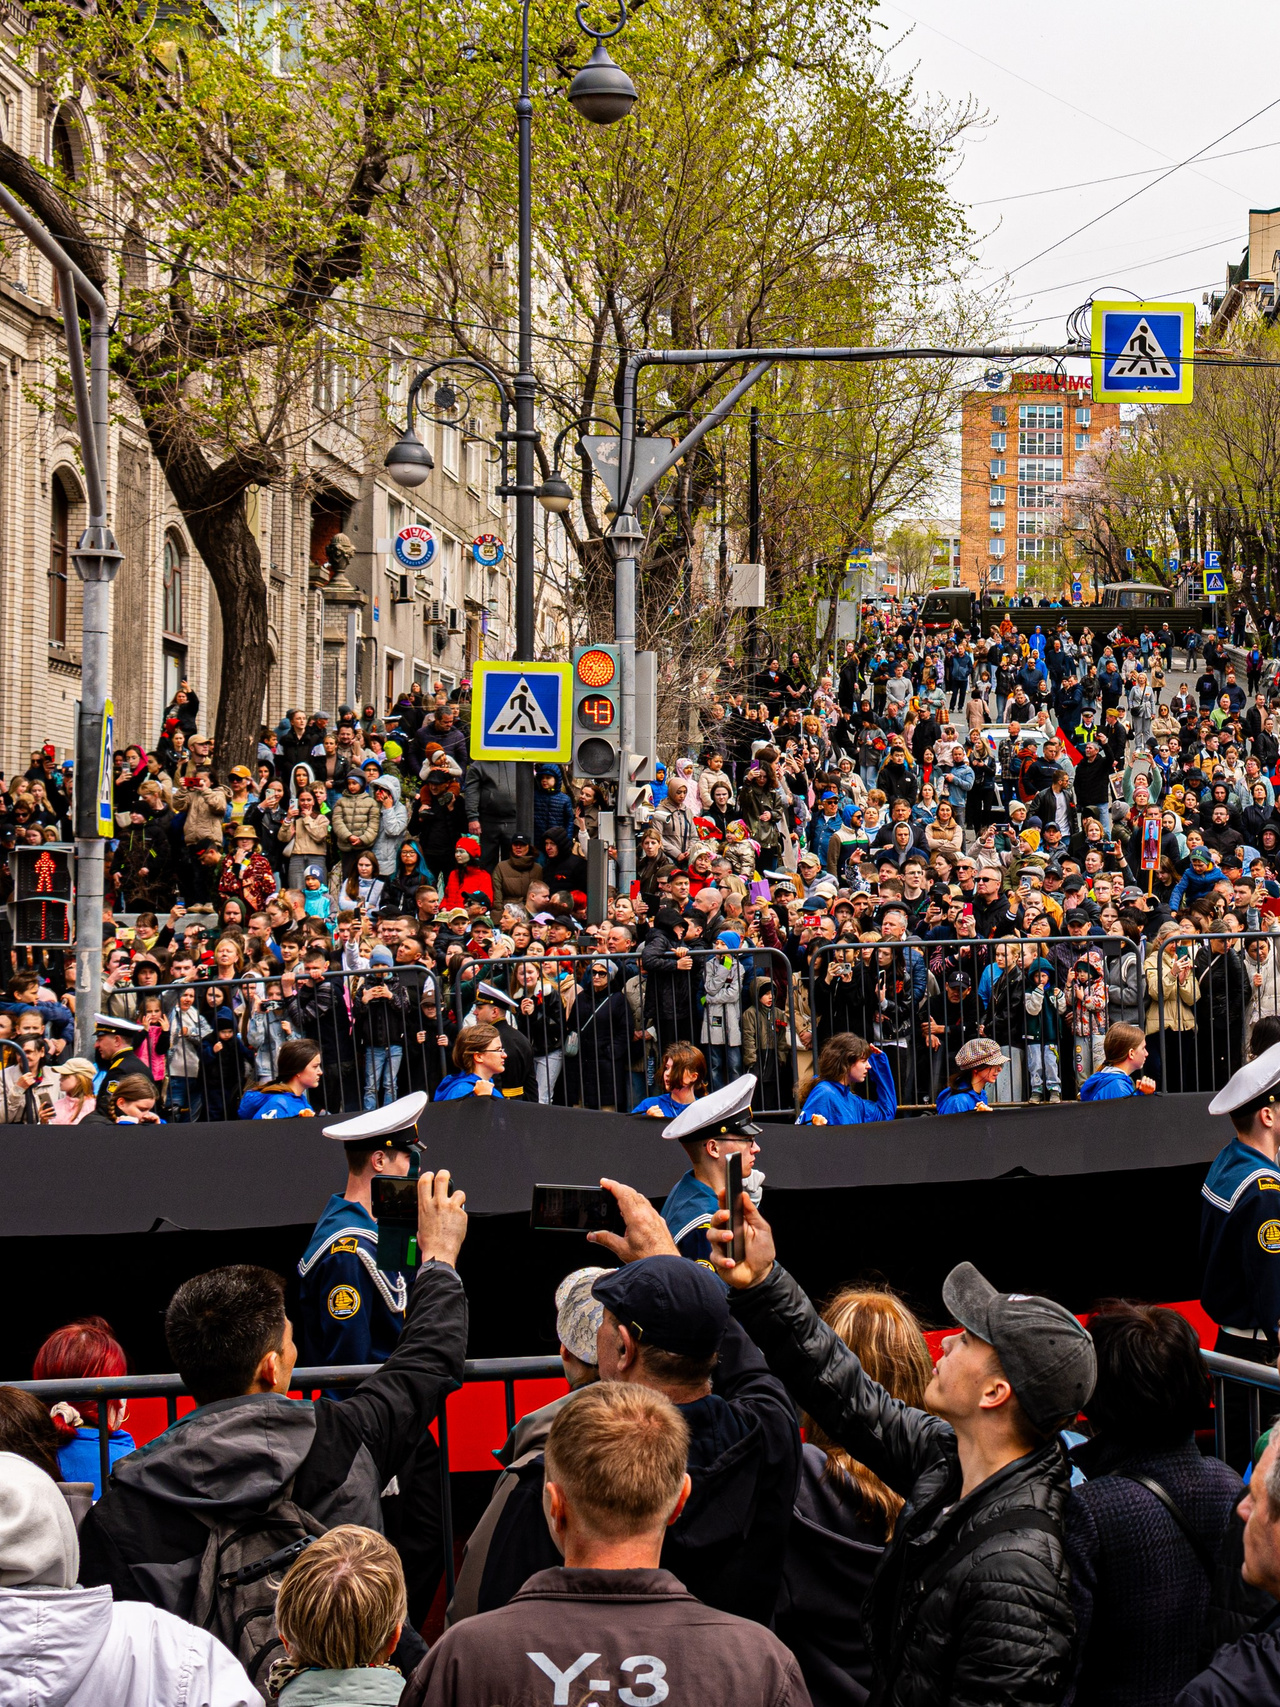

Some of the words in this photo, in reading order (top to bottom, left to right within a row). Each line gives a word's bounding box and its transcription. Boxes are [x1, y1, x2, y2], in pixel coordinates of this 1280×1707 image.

[400, 528, 432, 541] ГУМ
[584, 700, 611, 724] 43
[525, 1652, 670, 1707] Y-3
